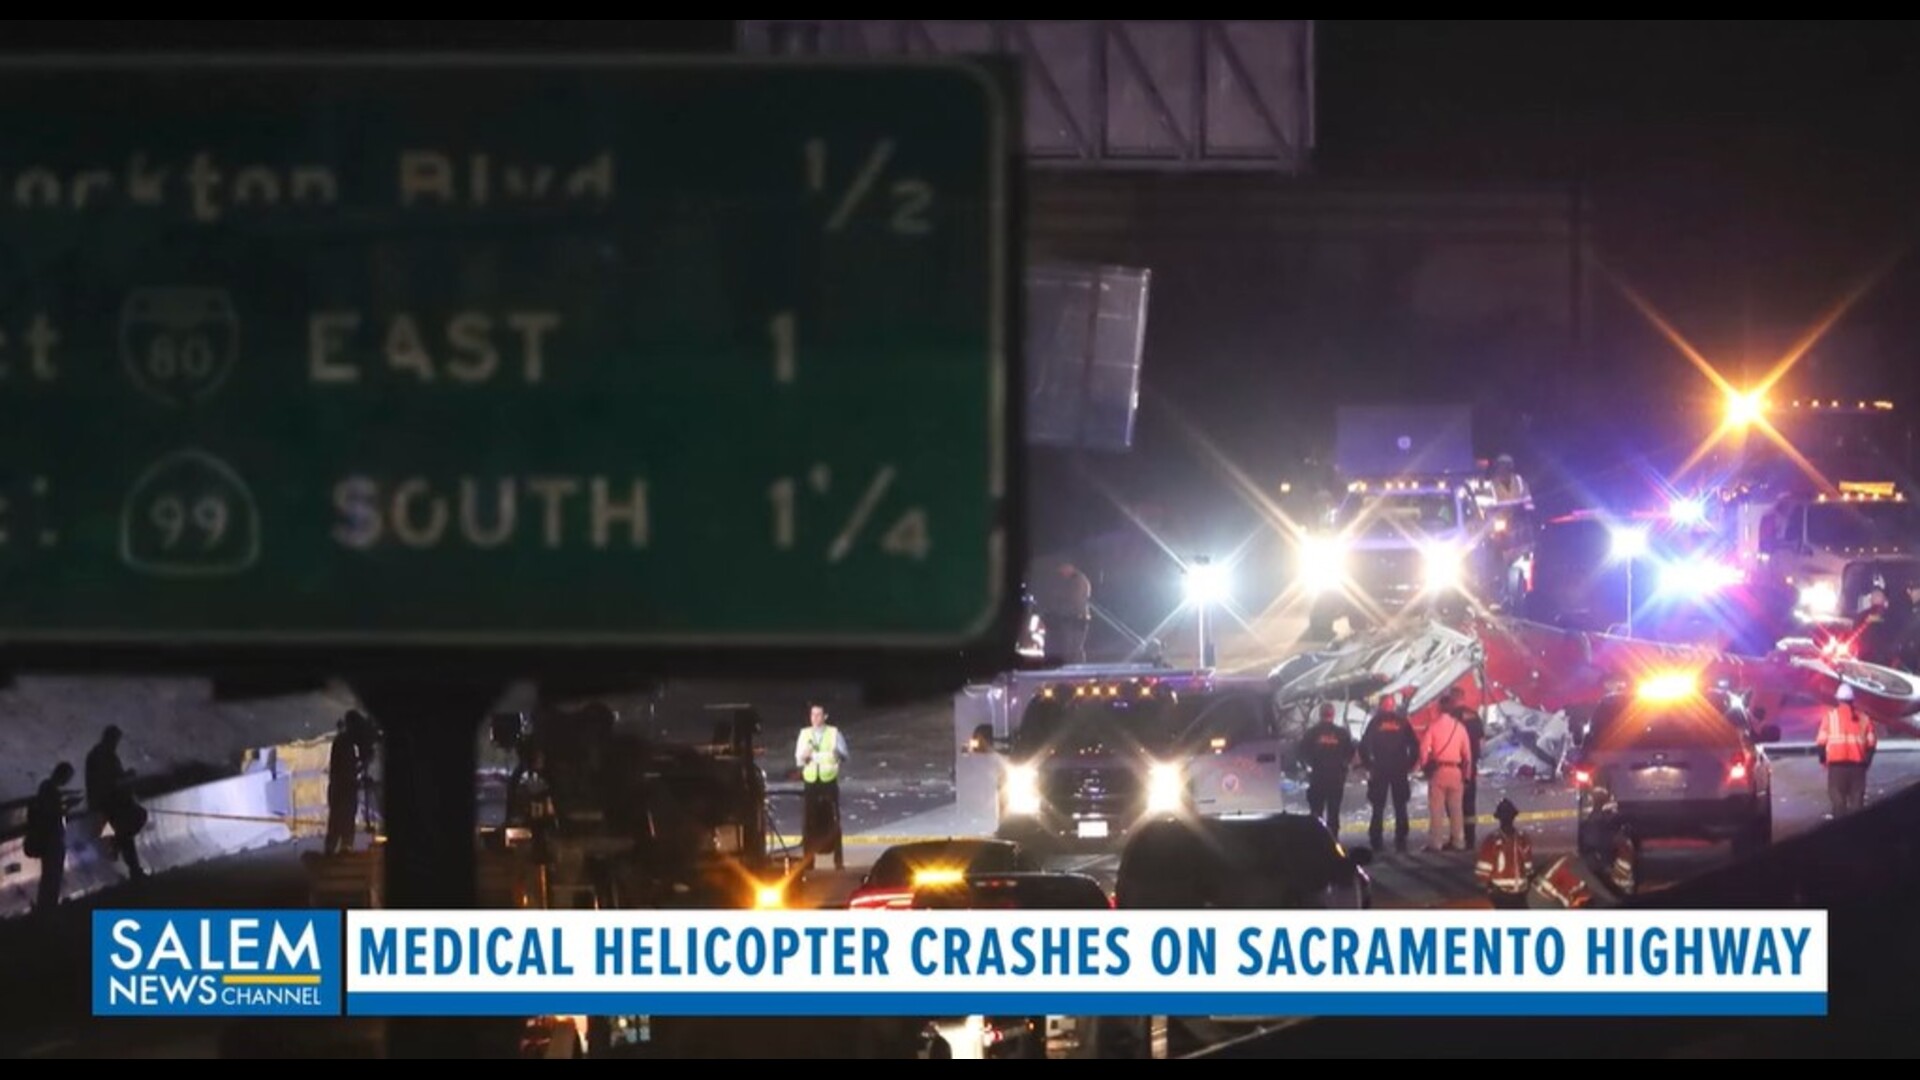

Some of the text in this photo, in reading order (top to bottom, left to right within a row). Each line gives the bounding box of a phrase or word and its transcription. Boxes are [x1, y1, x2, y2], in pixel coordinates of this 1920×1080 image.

[148, 335, 214, 379] 80
[307, 311, 796, 384] EAST 1
[150, 496, 229, 548] 99
[331, 475, 649, 550] SOUTH
